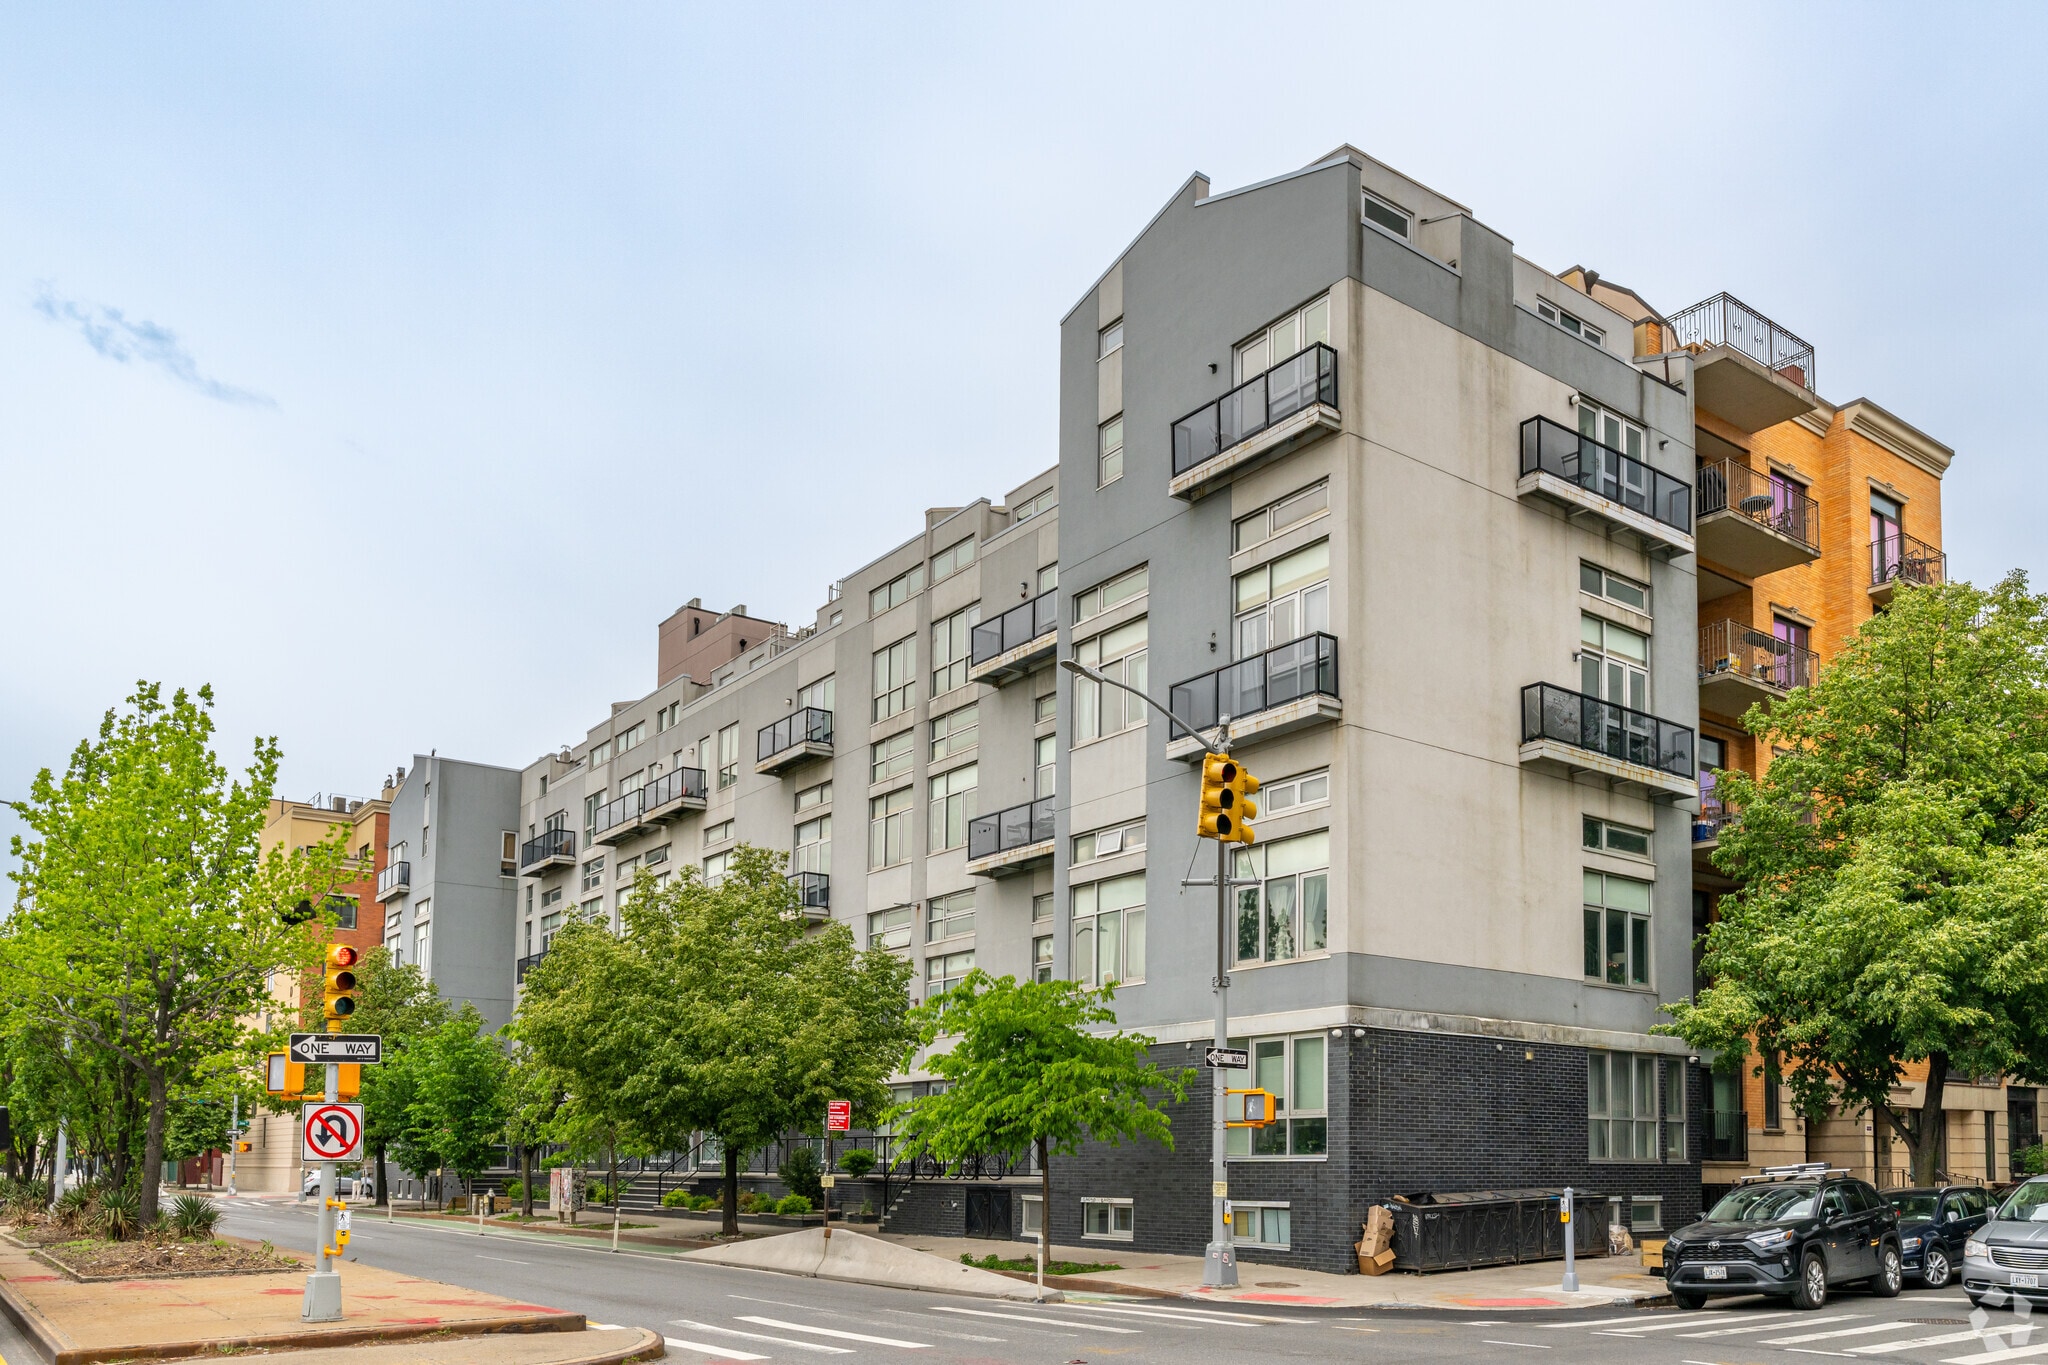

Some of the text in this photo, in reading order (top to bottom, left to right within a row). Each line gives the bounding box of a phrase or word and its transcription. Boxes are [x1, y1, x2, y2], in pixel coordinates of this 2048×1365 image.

[300, 1043, 373, 1054] ONE WAY
[1210, 1053, 1245, 1063] ONE WAY
